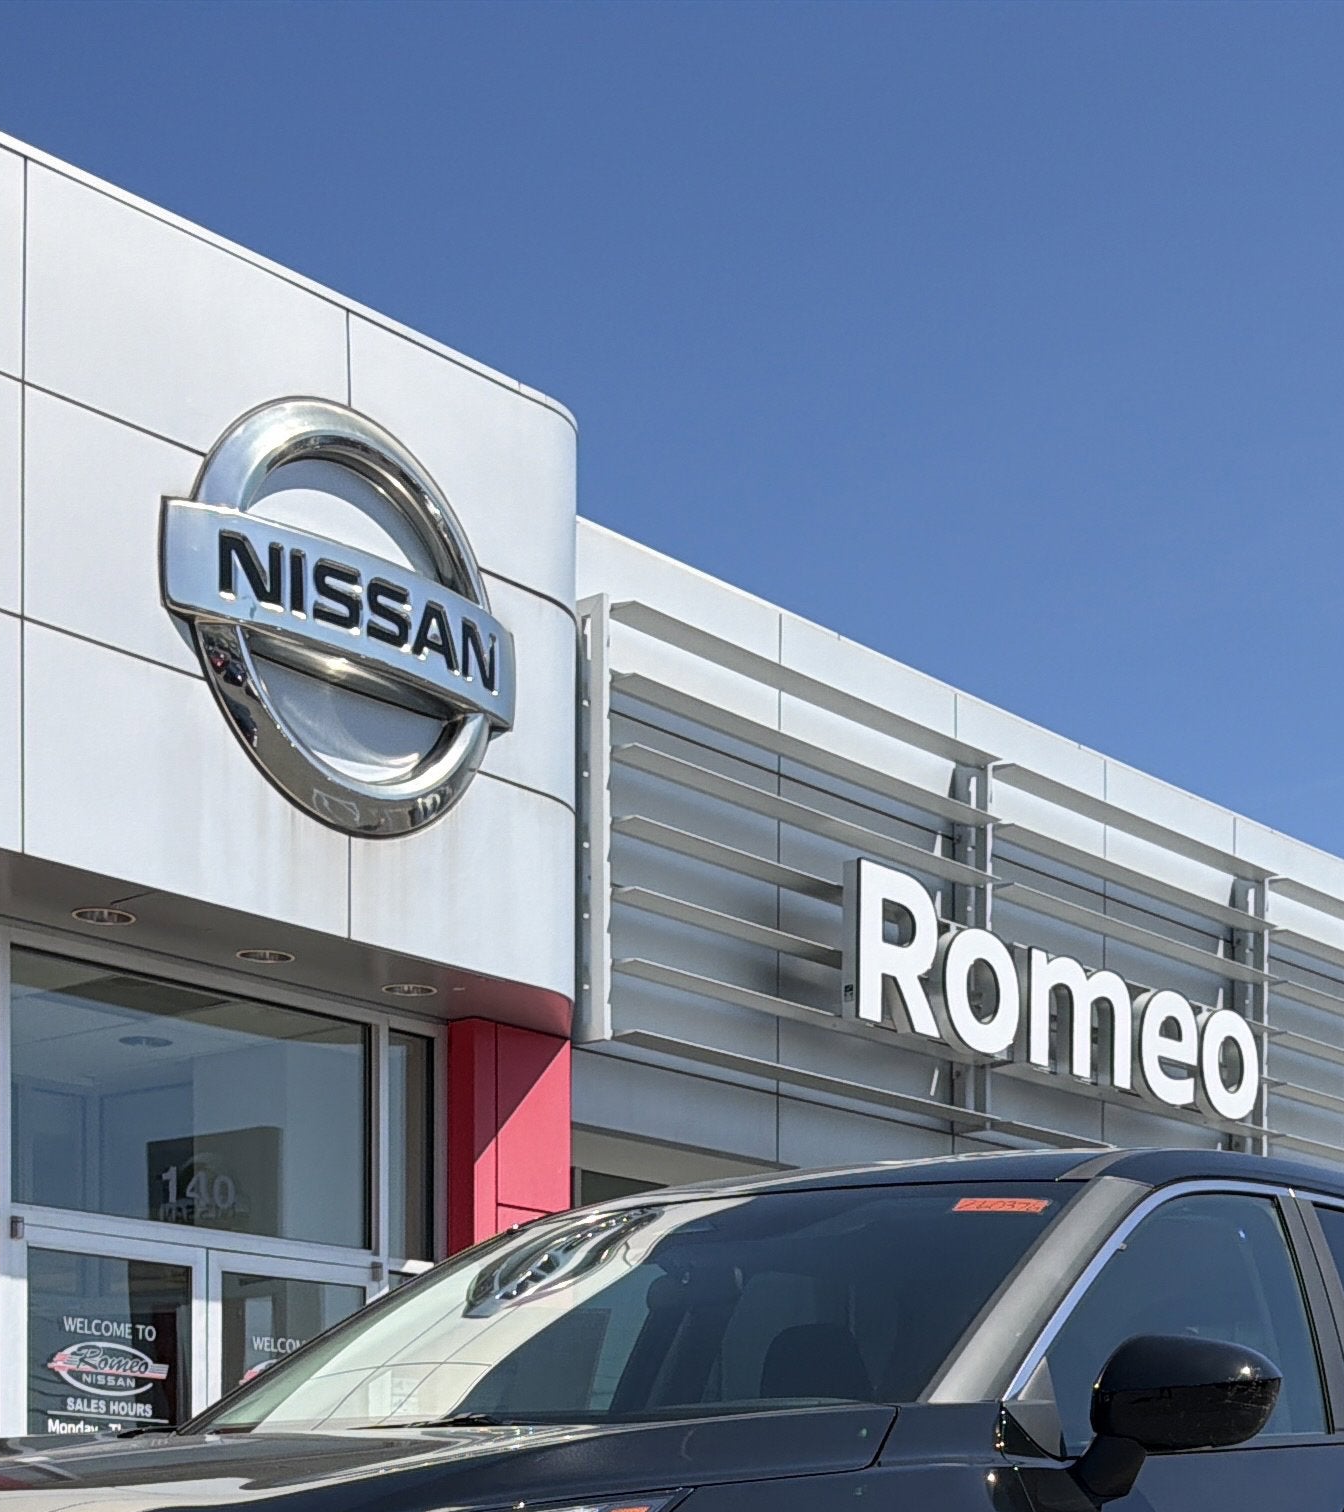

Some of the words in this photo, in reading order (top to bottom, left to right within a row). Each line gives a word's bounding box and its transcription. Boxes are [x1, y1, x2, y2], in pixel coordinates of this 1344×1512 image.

[217, 527, 499, 697] NISSAN
[851, 856, 1259, 1121] Romeo
[161, 1166, 236, 1209] 140
[63, 1315, 133, 1340] WELCOME
[135, 1323, 157, 1342] TO
[71, 1345, 150, 1375] Romeo
[82, 1373, 136, 1389] NISSAN
[66, 1397, 107, 1414] SALES
[109, 1400, 153, 1417] HOURS
